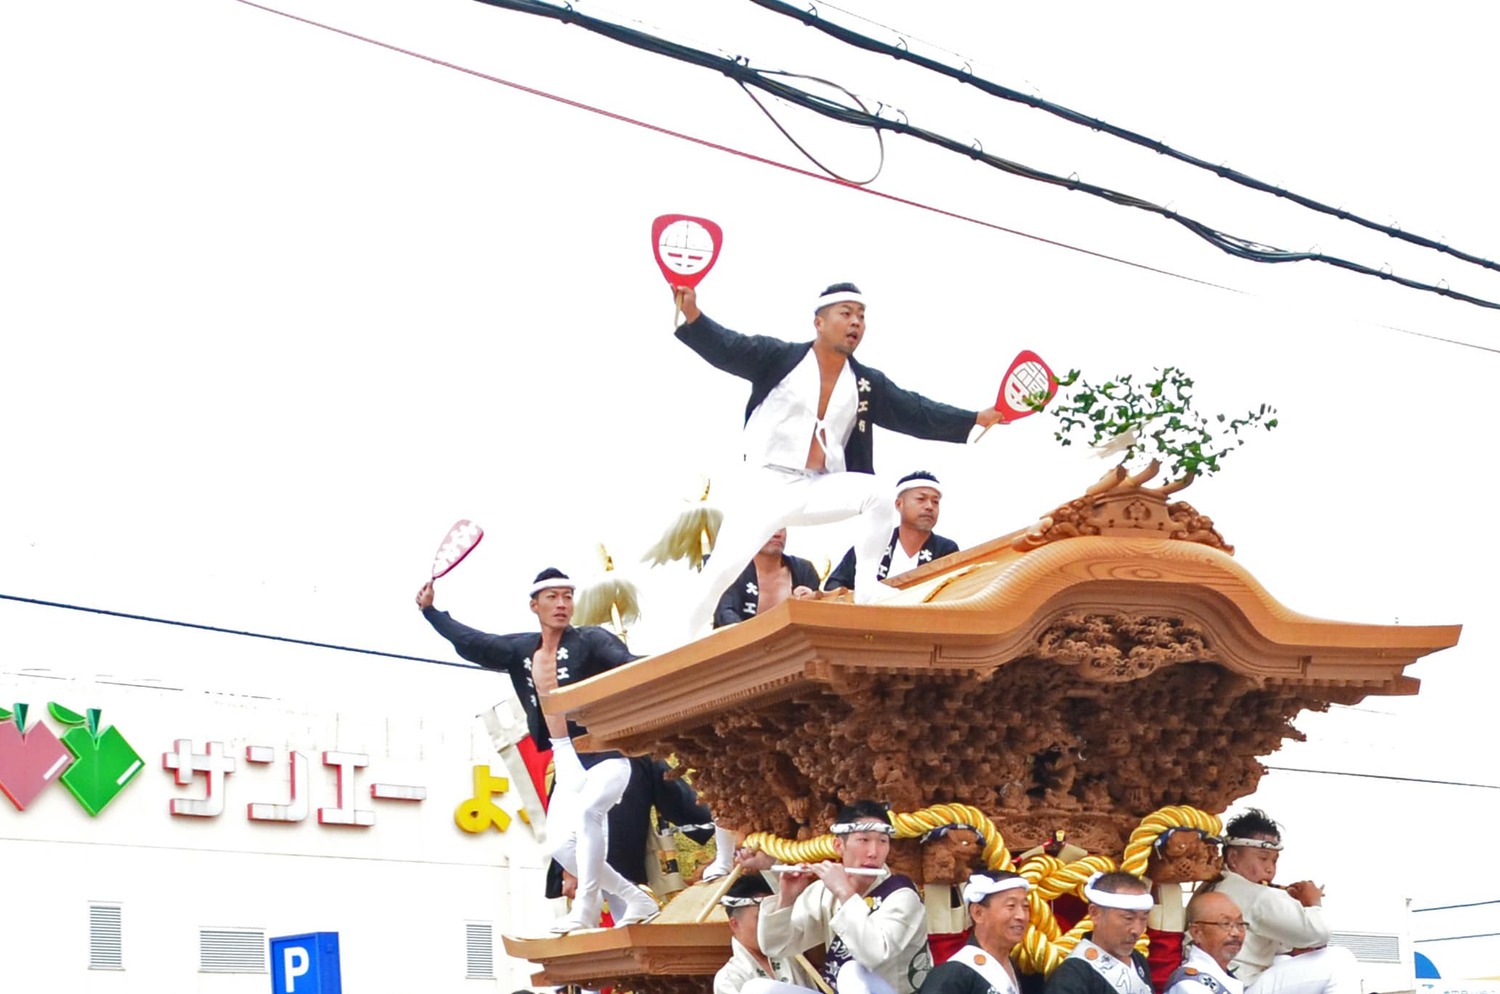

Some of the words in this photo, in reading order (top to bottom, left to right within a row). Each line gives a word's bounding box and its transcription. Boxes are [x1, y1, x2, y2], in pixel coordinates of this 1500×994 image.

[163, 738, 426, 826] サンエー
[455, 765, 530, 834] よ
[283, 947, 309, 993] P
